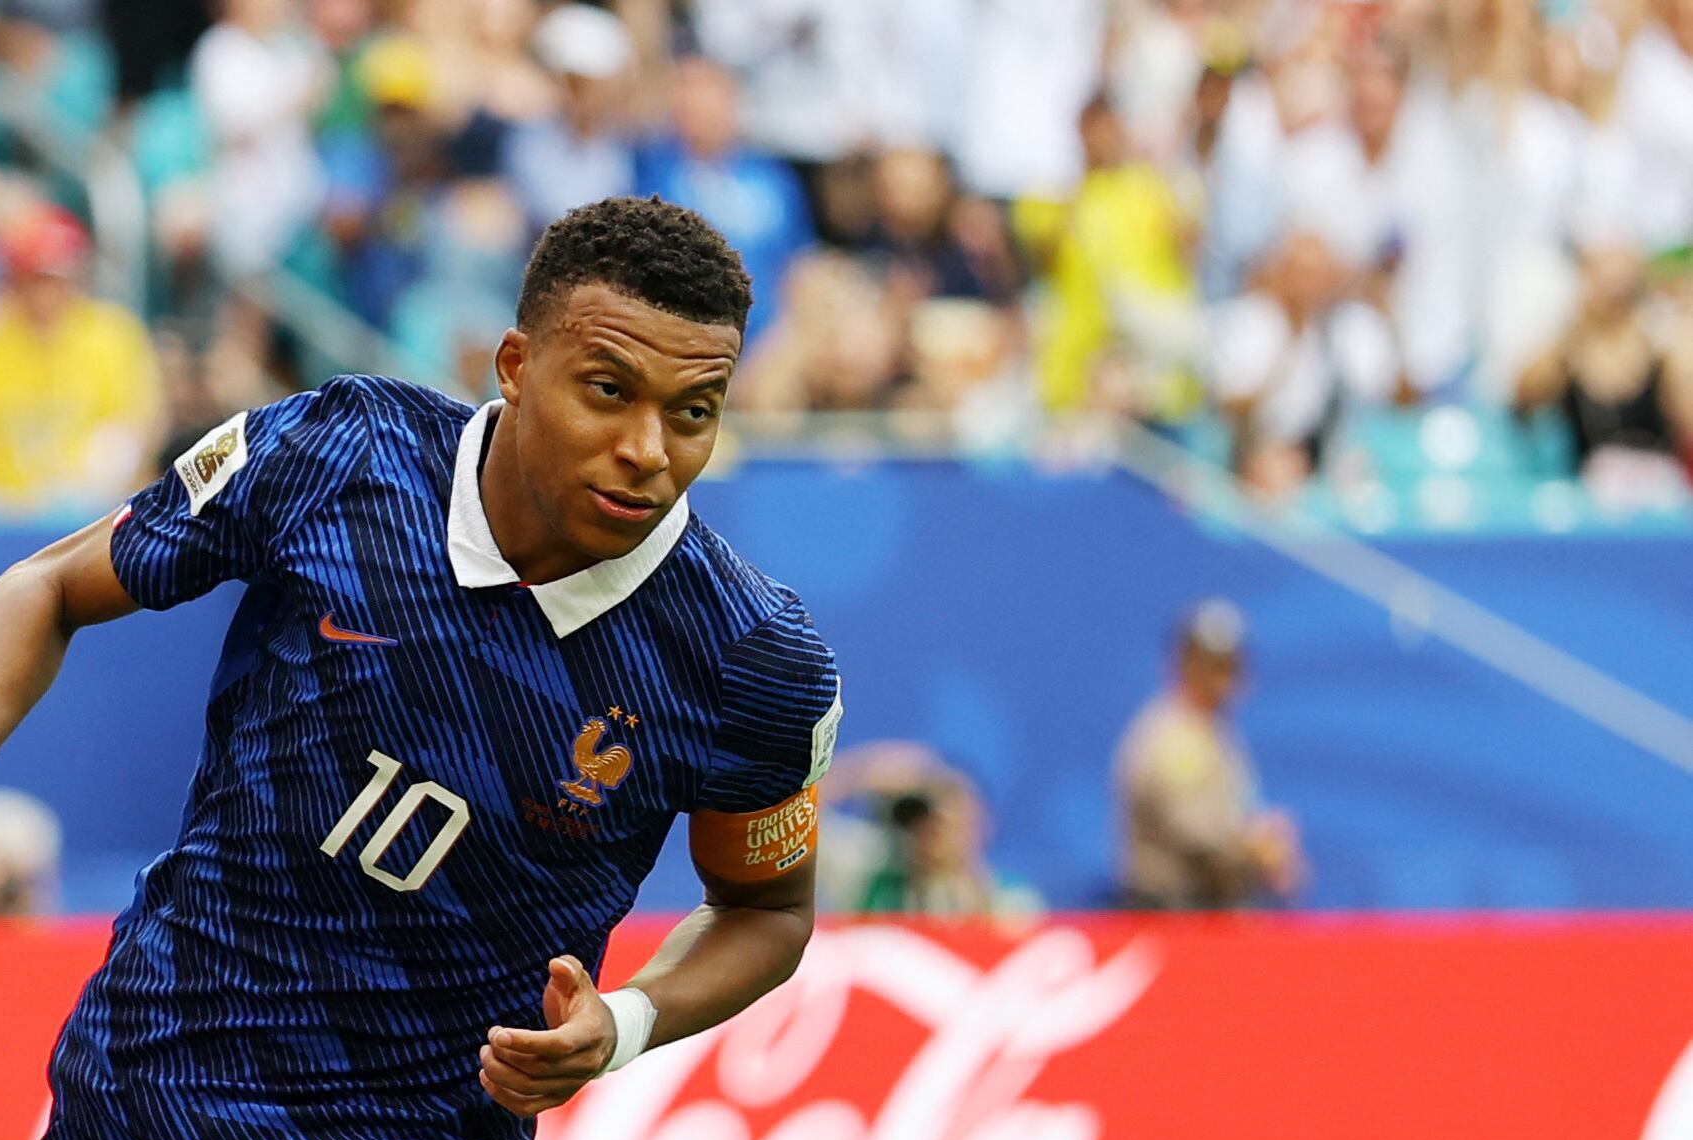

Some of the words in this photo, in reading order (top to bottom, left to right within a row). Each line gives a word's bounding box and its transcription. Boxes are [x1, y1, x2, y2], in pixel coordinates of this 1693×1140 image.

[319, 749, 471, 893] 10
[747, 802, 814, 849] UNITES
[743, 849, 778, 865] the
[779, 848, 805, 868] FIFA
